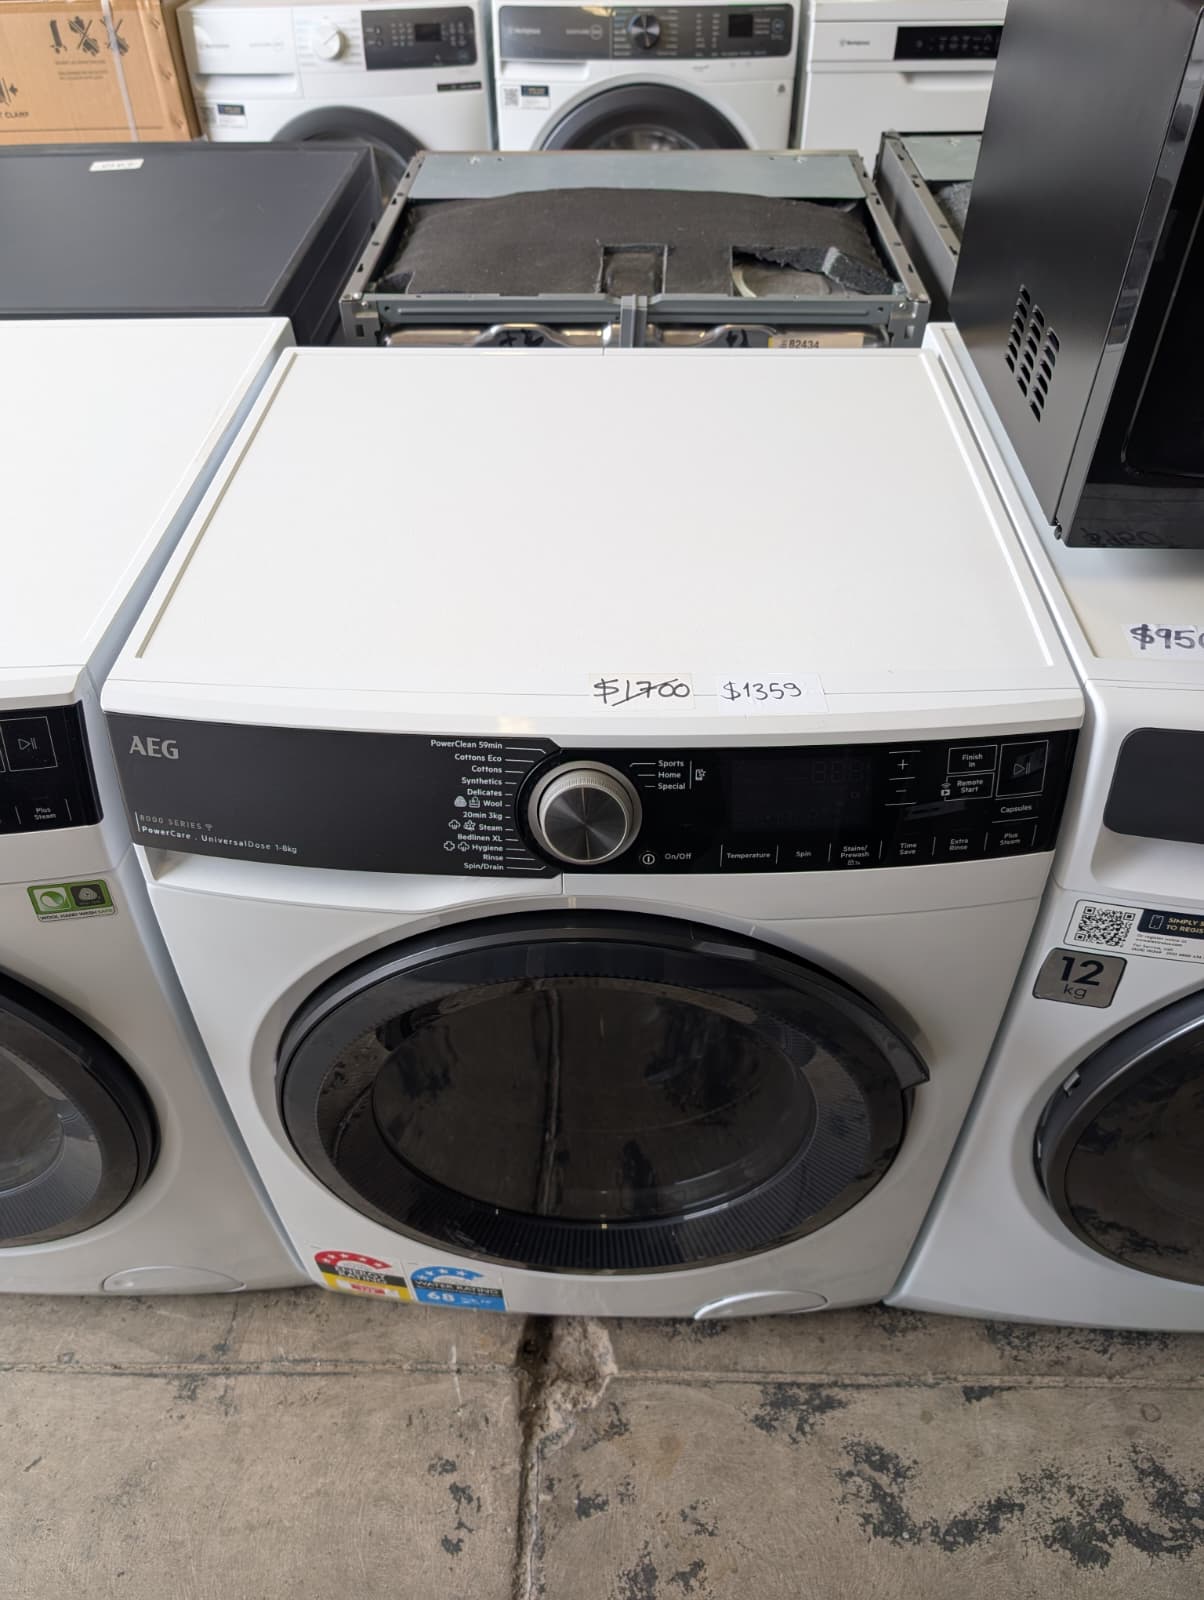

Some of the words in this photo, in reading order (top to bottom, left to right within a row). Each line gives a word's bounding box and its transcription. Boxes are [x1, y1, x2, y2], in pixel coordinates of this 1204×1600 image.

[720, 681, 802, 701] $1359
[129, 735, 179, 759] AEG
[430, 739, 477, 749] PowerClean
[478, 741, 503, 750] 59min
[454, 753, 486, 762] Cottons
[487, 755, 502, 763] Eco
[961, 753, 983, 761] Finish
[657, 760, 685, 768] Sports
[471, 765, 502, 774] Cottons
[657, 771, 681, 779] Home
[461, 777, 502, 786] Synthetics
[956, 778, 984, 787] Remote
[657, 783, 686, 791] Special
[960, 786, 979, 794] Start
[467, 788, 502, 797] Delicates
[483, 800, 503, 808] Wool
[1000, 804, 1033, 814] Capsules
[463, 811, 487, 819] 20min
[488, 812, 503, 821] 3kg
[168, 819, 202, 830] SERIES
[479, 823, 503, 832] Steam
[141, 825, 191, 839] PowerCare
[201, 834, 271, 850] UniversalDose
[457, 833, 490, 841] Bedlinen
[492, 834, 503, 842] XL
[950, 837, 969, 845] Extra
[472, 844, 503, 853] Hygiene
[664, 853, 692, 861] On/Off
[727, 852, 771, 861] Temperature
[796, 850, 812, 859] Spin
[464, 862, 504, 871] Spin/Drain
[1168, 917, 1197, 926] SIMPLY
[1060, 956, 1104, 986] 12
[1063, 984, 1087, 999] kg
